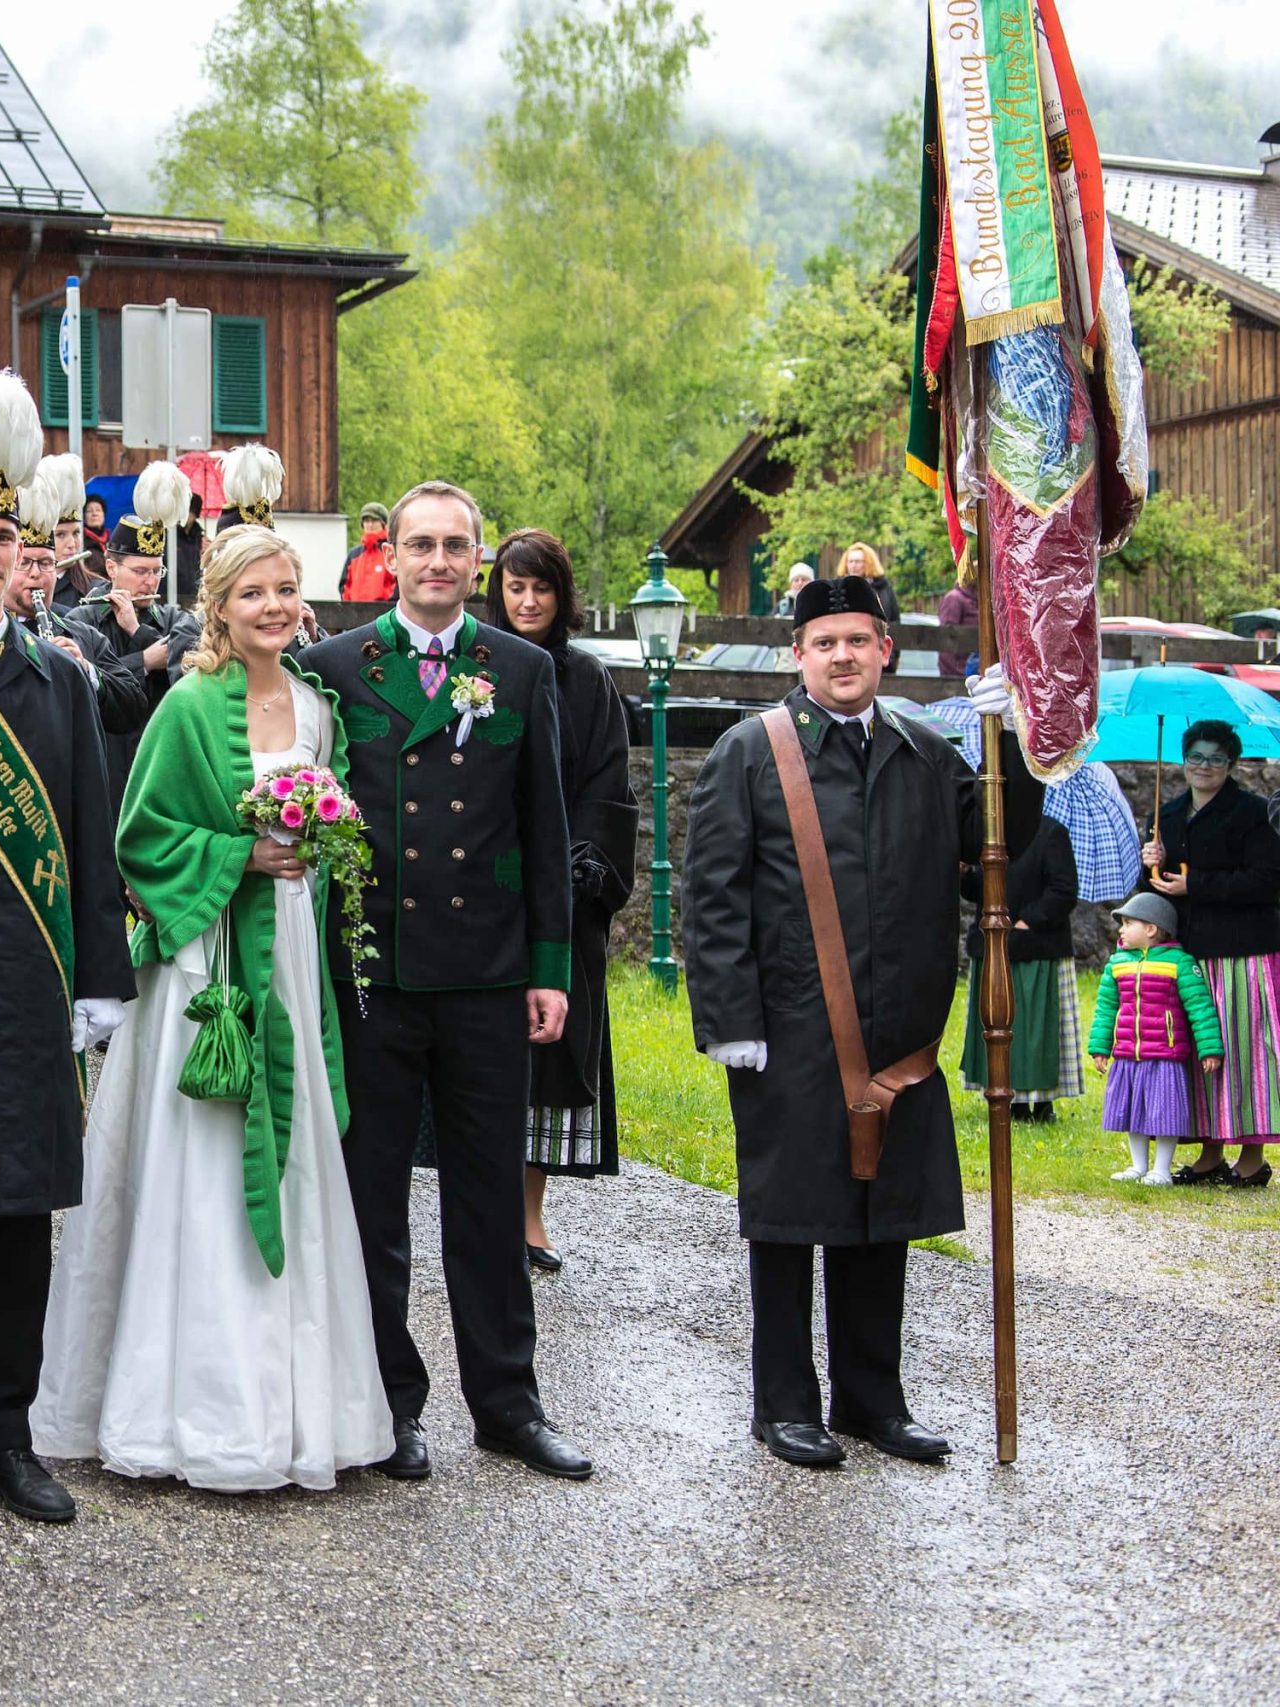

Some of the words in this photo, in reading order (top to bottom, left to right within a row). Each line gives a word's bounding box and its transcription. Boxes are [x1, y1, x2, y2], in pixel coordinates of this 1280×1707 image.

[995, 8, 1031, 127] Aussee
[959, 52, 1003, 281] Bundestagung
[1003, 133, 1040, 215] Bad
[8, 778, 48, 842] Musik
